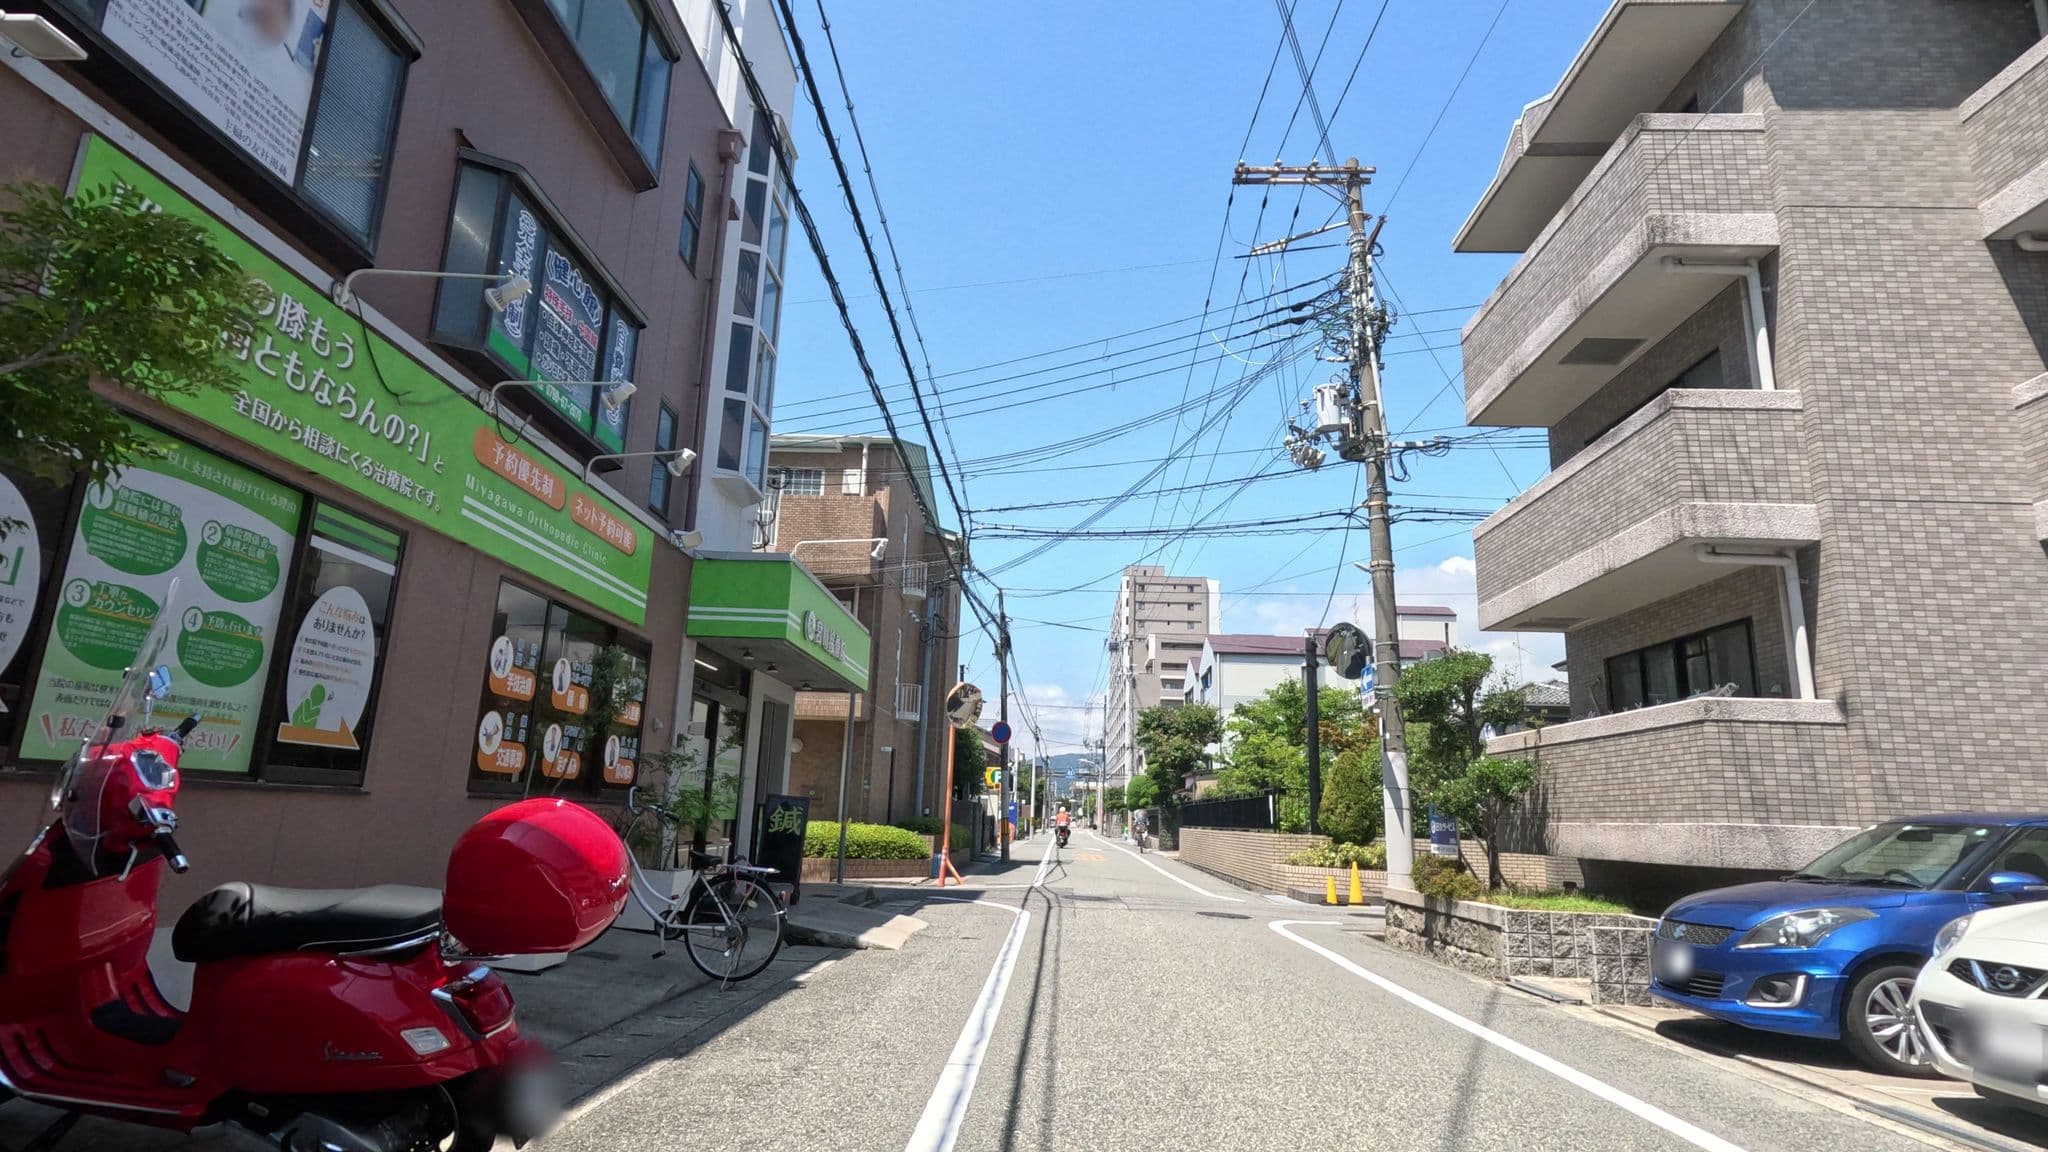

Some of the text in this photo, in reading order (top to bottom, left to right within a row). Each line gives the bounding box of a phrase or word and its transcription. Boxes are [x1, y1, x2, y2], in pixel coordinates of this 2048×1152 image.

[231, 388, 441, 512] 全国から相談にくる治療院です。
[492, 440, 554, 499] 予約優先制
[465, 474, 609, 566] Miyagawa Orthopedic Clinic
[575, 497, 632, 550] ネット予約可能
[312, 618, 366, 641] ありませんか?
[768, 804, 804, 836] 鍼
